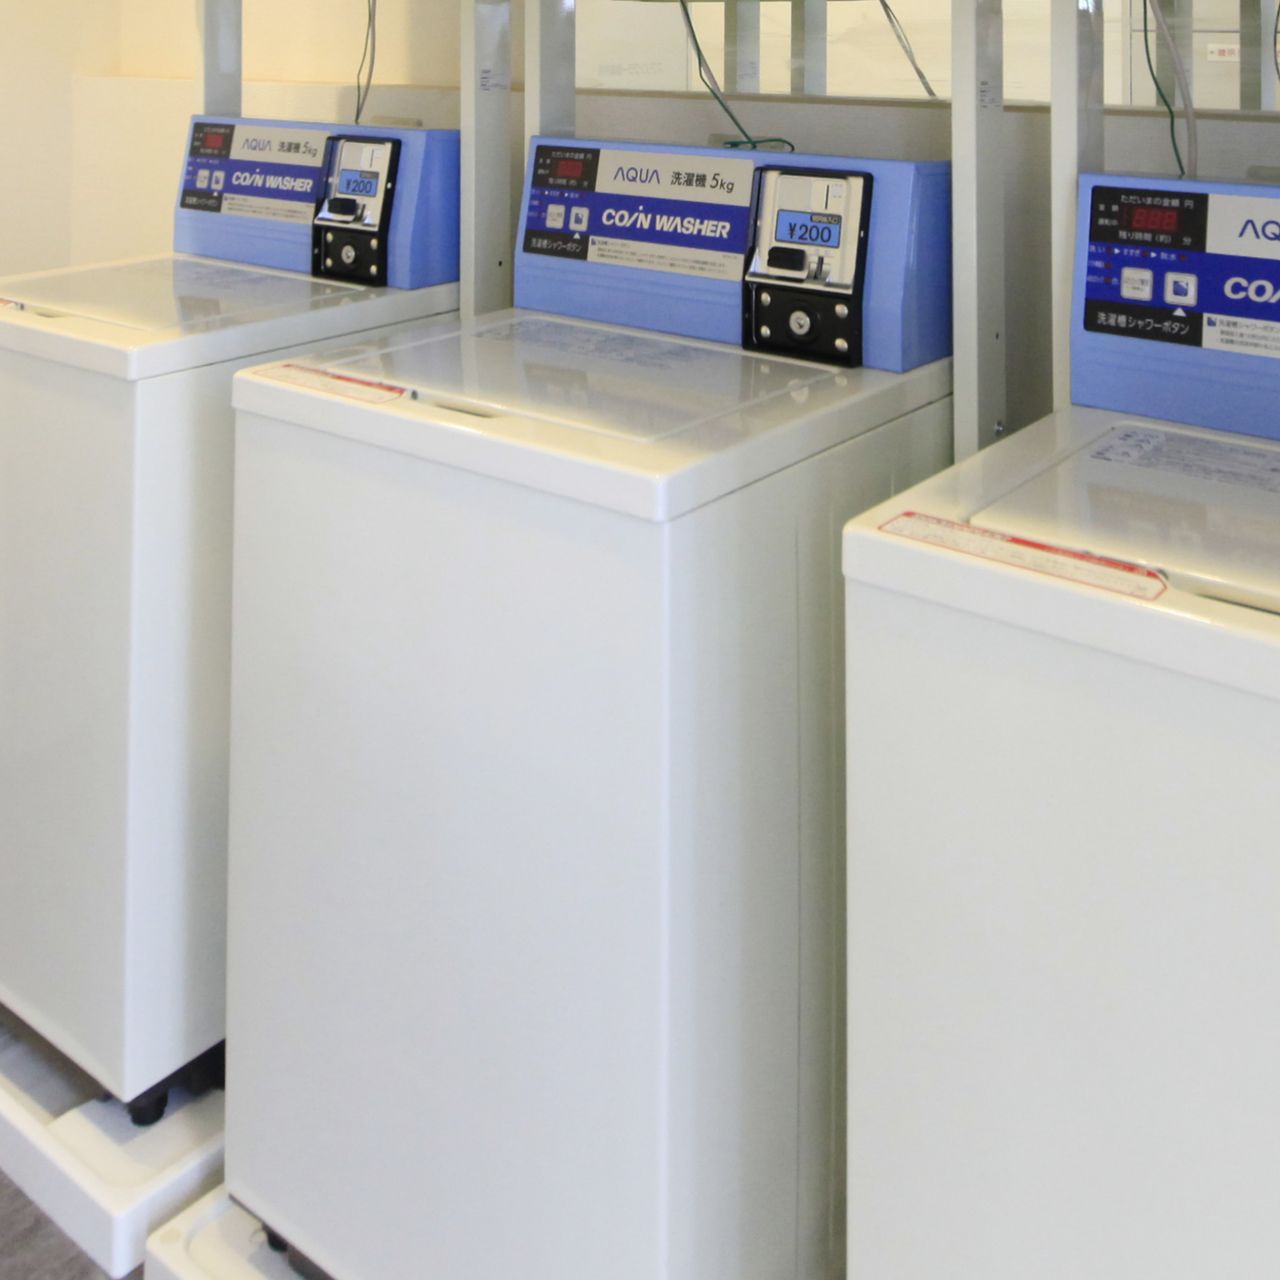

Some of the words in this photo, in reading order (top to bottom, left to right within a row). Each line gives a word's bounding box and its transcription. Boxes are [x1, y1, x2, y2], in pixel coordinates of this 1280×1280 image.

[242, 138, 272, 152] AQUA
[232, 168, 263, 187] COIN
[265, 175, 313, 192] WASHER
[345, 179, 372, 194] ¥200
[613, 167, 660, 185] AQUA
[671, 171, 706, 188] 洗濯機
[709, 173, 735, 194] 5kg
[1120, 195, 1180, 208] ただいまの金額
[1184, 200, 1194, 209] 円
[602, 205, 652, 230] COIN
[654, 217, 731, 239] WASHER
[788, 222, 832, 243] ¥200
[1183, 237, 1192, 246] 分
[1097, 311, 1191, 336] 洗濯槽シャワーボタン
